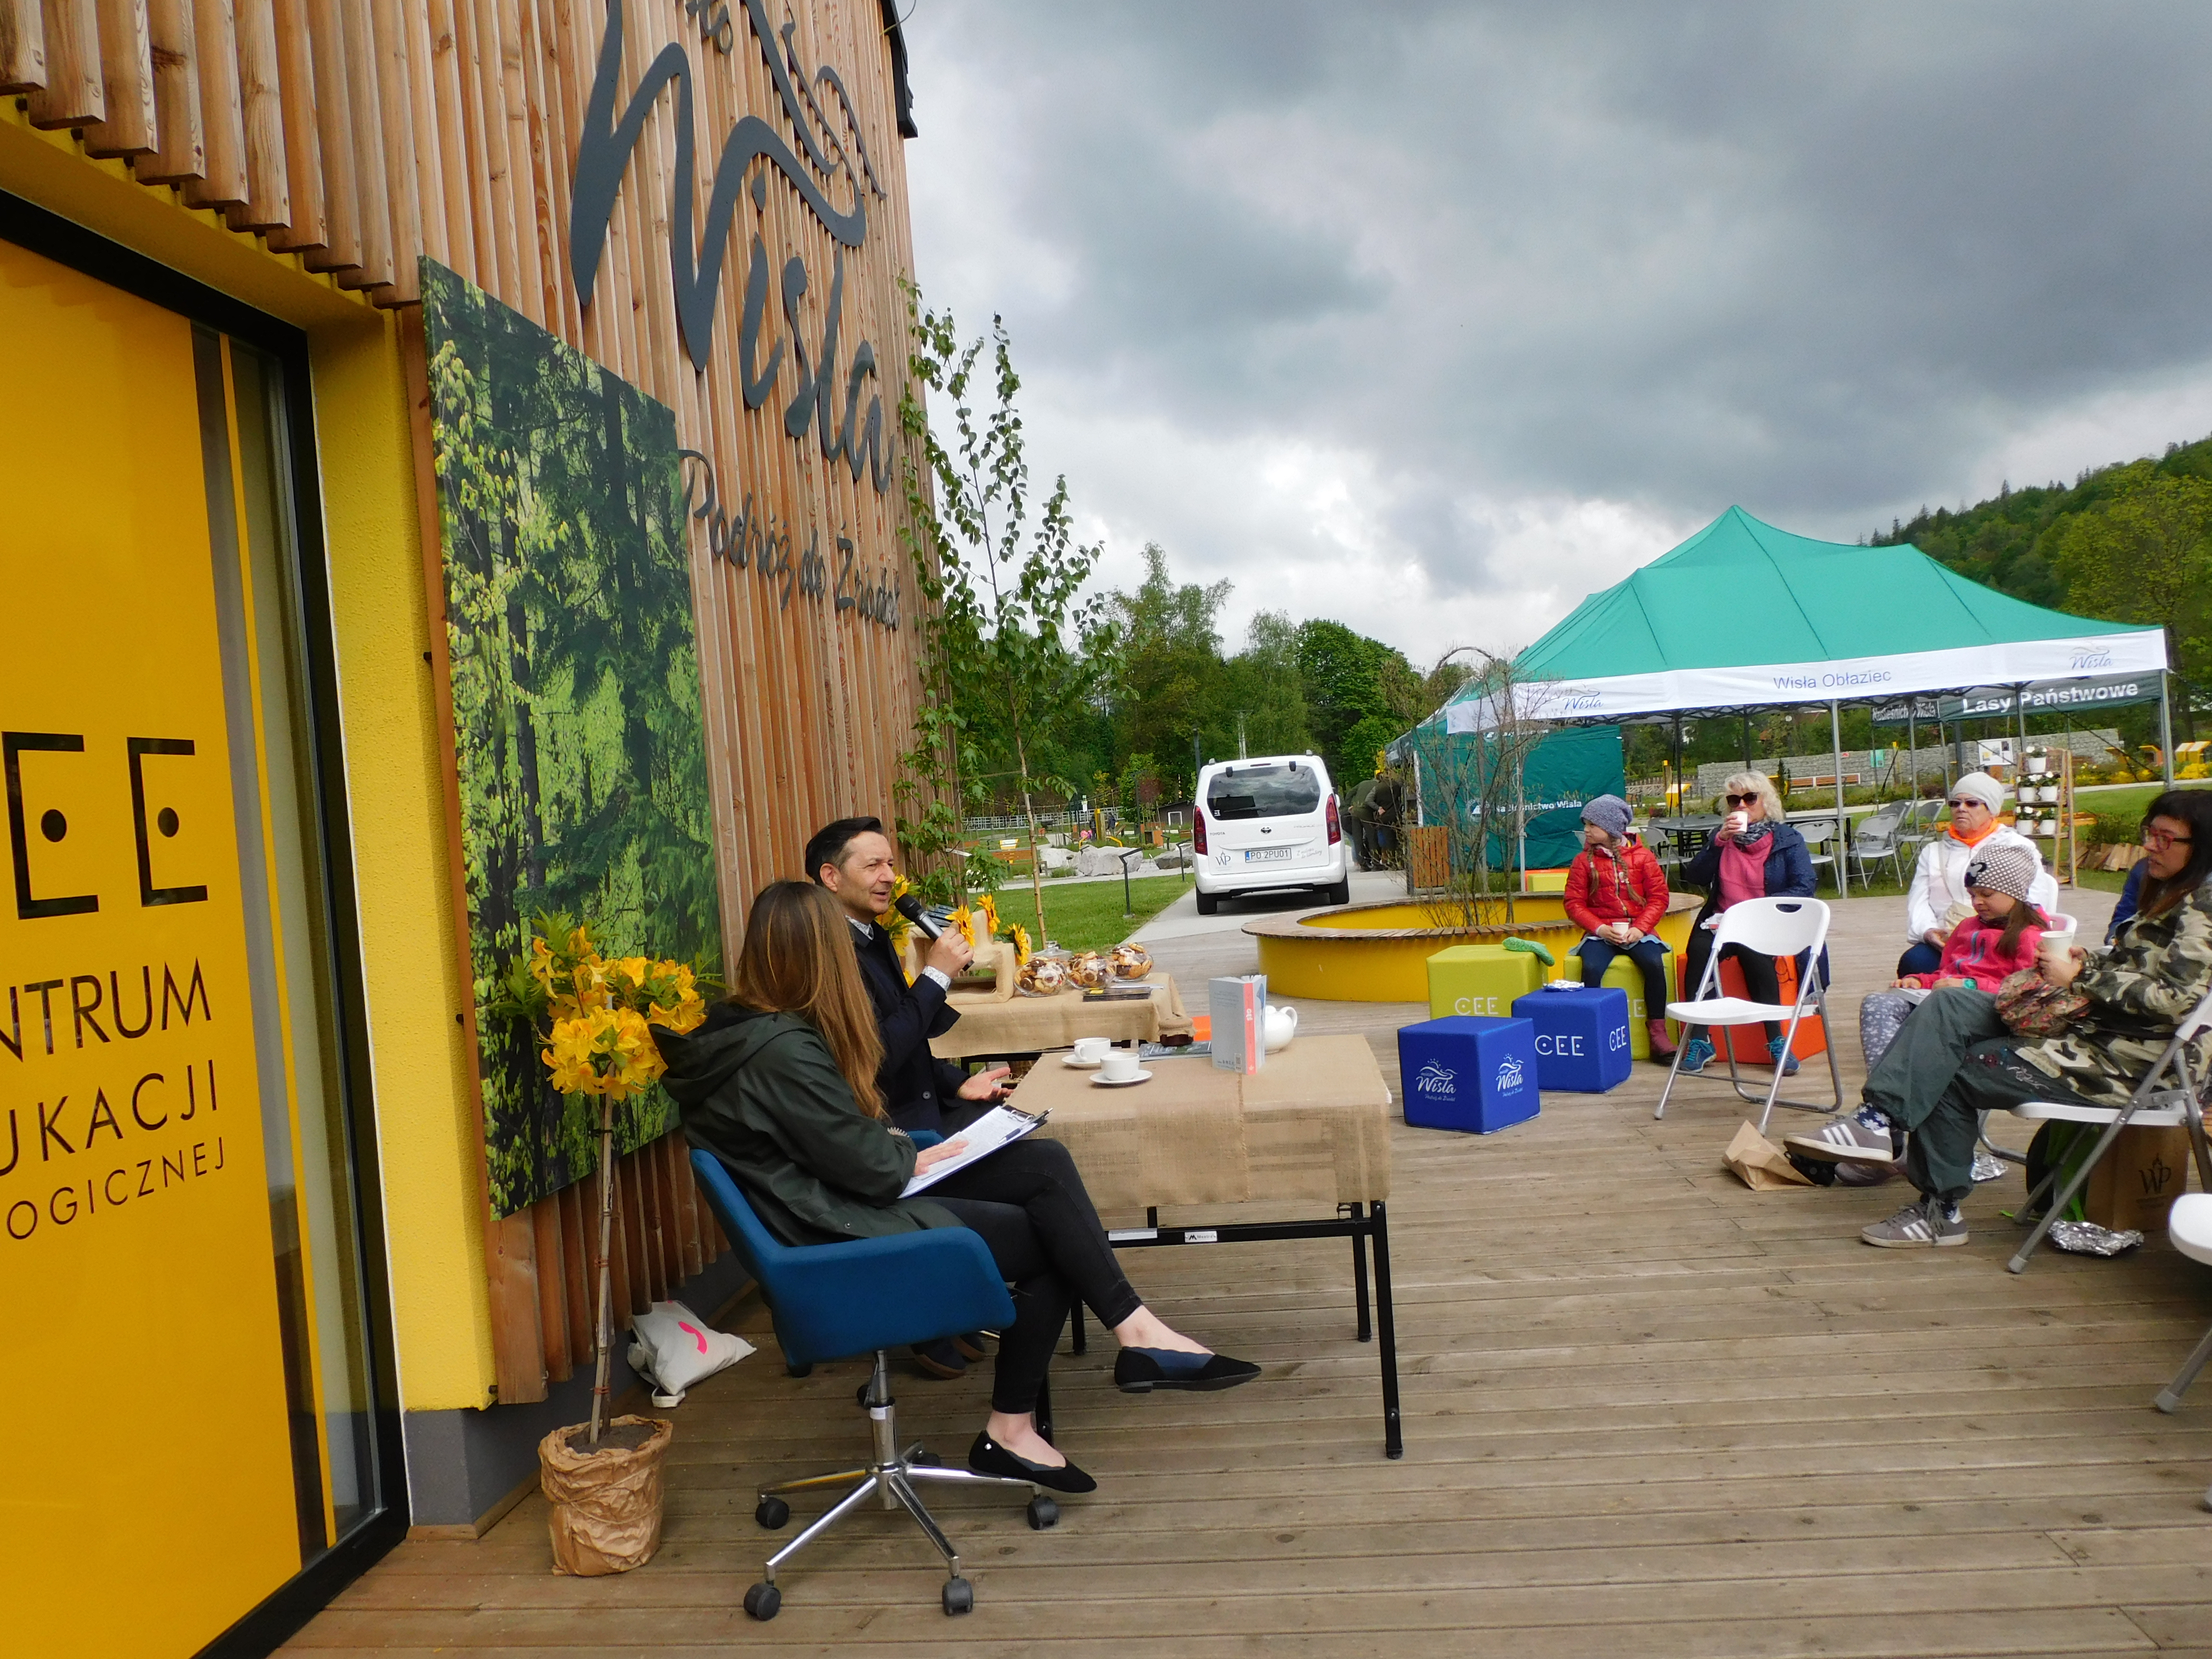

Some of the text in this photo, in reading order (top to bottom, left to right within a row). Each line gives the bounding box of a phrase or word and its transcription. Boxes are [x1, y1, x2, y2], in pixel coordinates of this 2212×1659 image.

[800, 529, 827, 599] do
[1773, 670, 1892, 689] Wisła Obłaziec
[1962, 683, 2139, 713] Lasy Państwowe
[1264, 850, 1288, 859] 2PU01
[1455, 997, 1498, 1016] CEE
[1535, 1034, 1584, 1056] CEE
[1609, 1025, 1627, 1051] CEE
